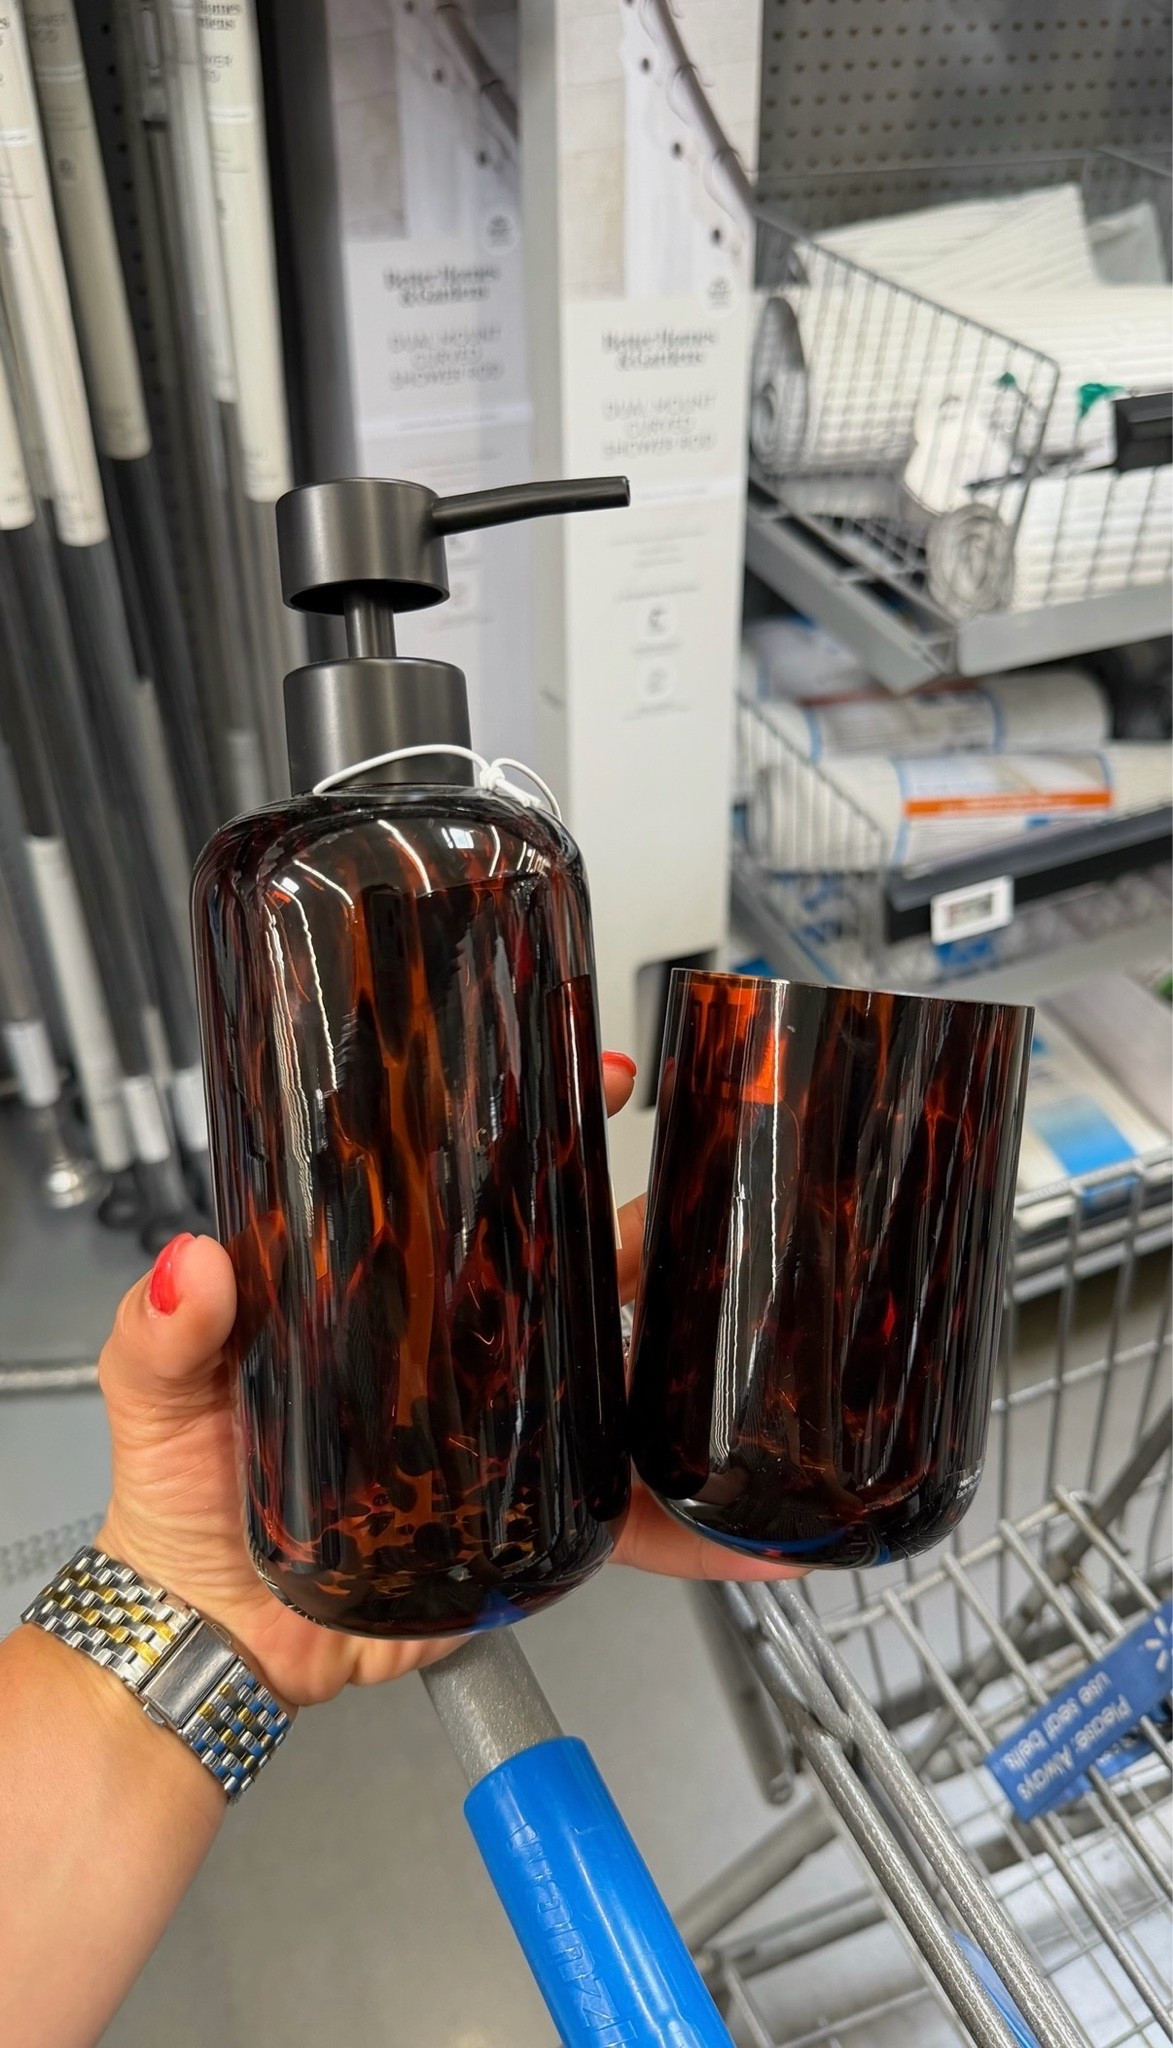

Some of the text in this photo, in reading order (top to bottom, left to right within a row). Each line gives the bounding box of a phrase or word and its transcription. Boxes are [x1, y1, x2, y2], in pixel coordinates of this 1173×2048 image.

[1077, 1671, 1112, 1705] use
[1042, 1697, 1083, 1742] seat
[1016, 1745, 1075, 1800] Always
